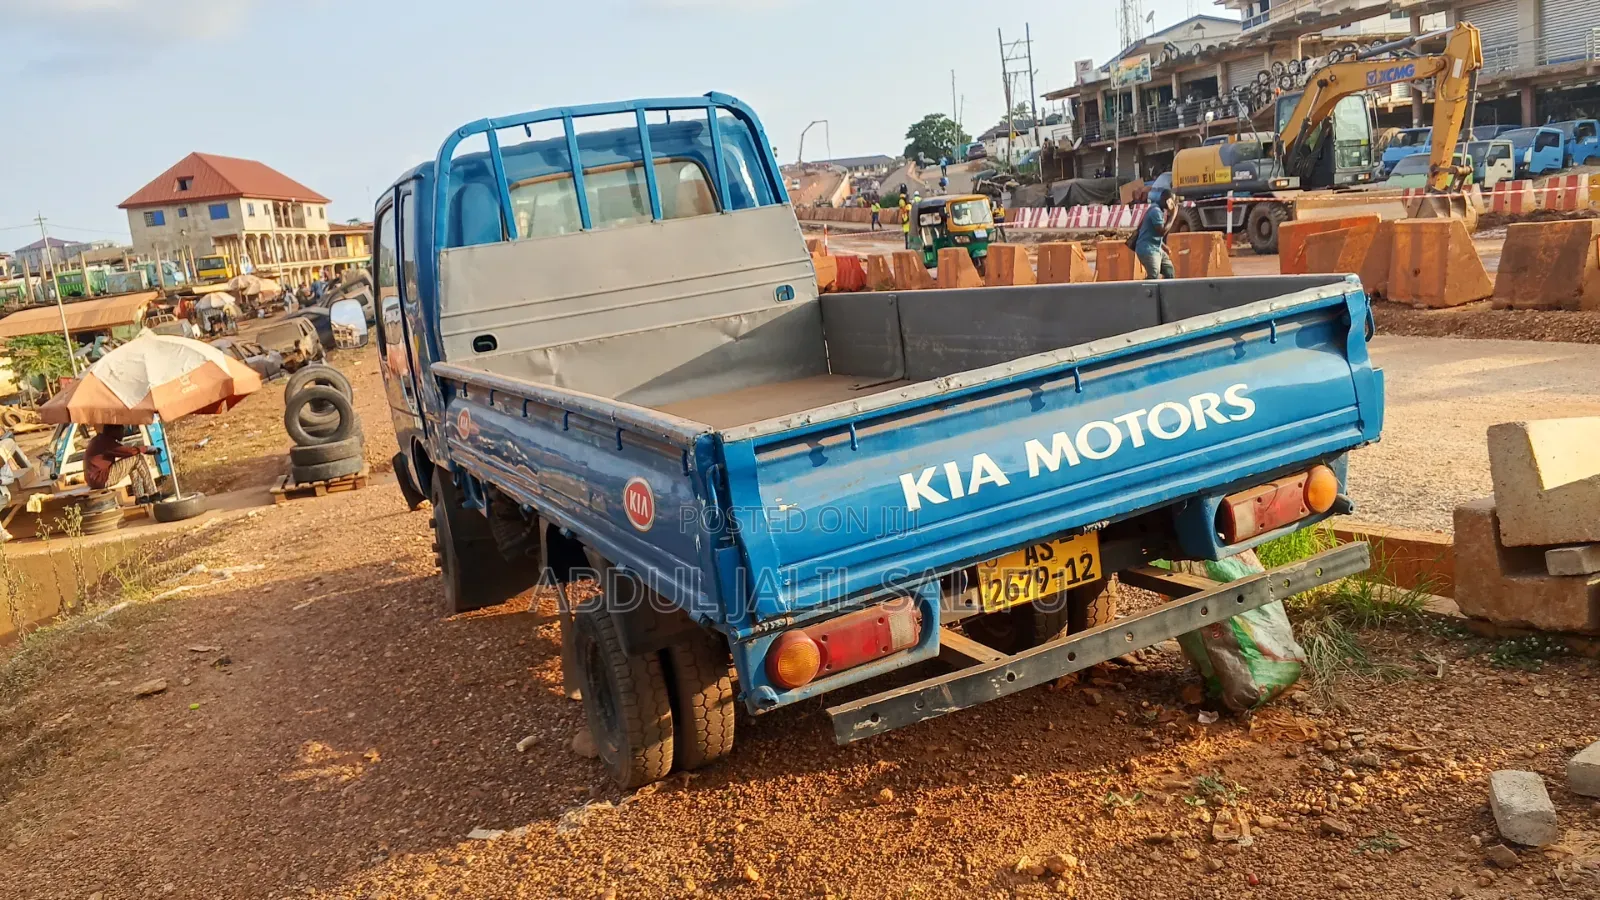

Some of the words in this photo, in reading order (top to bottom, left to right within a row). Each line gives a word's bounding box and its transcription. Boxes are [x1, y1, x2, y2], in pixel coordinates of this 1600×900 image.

[1377, 63, 1415, 83] XCMG
[899, 452, 1011, 512] KIA
[1023, 383, 1256, 478] MOTORS
[629, 489, 649, 519] KIA
[987, 552, 1096, 607] 2679-12
